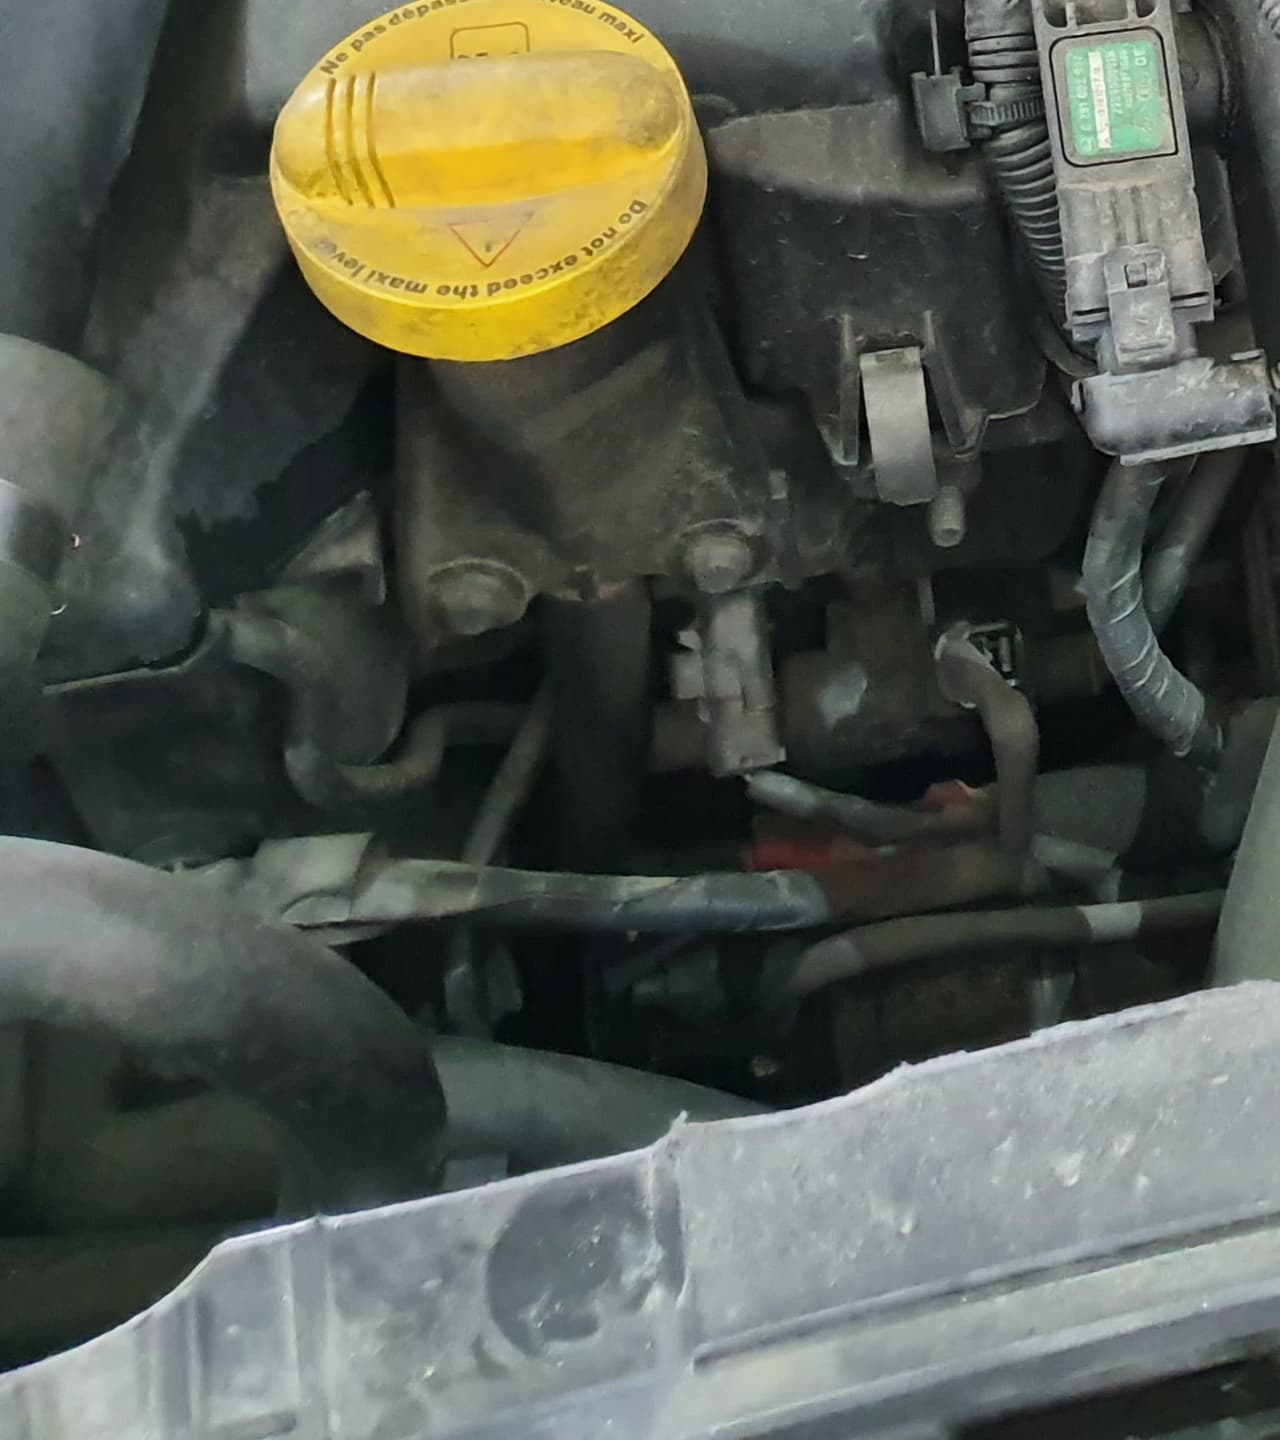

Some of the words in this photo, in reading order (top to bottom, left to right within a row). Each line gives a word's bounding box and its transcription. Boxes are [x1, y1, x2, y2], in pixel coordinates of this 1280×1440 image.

[320, 51, 349, 75] Ne
[350, 24, 387, 52] pas
[598, 11, 645, 44] maxi
[618, 199, 648, 225] Do
[580, 227, 618, 257] not
[364, 269, 429, 295] maxi
[486, 254, 578, 296] exceed
[436, 284, 480, 300] the
